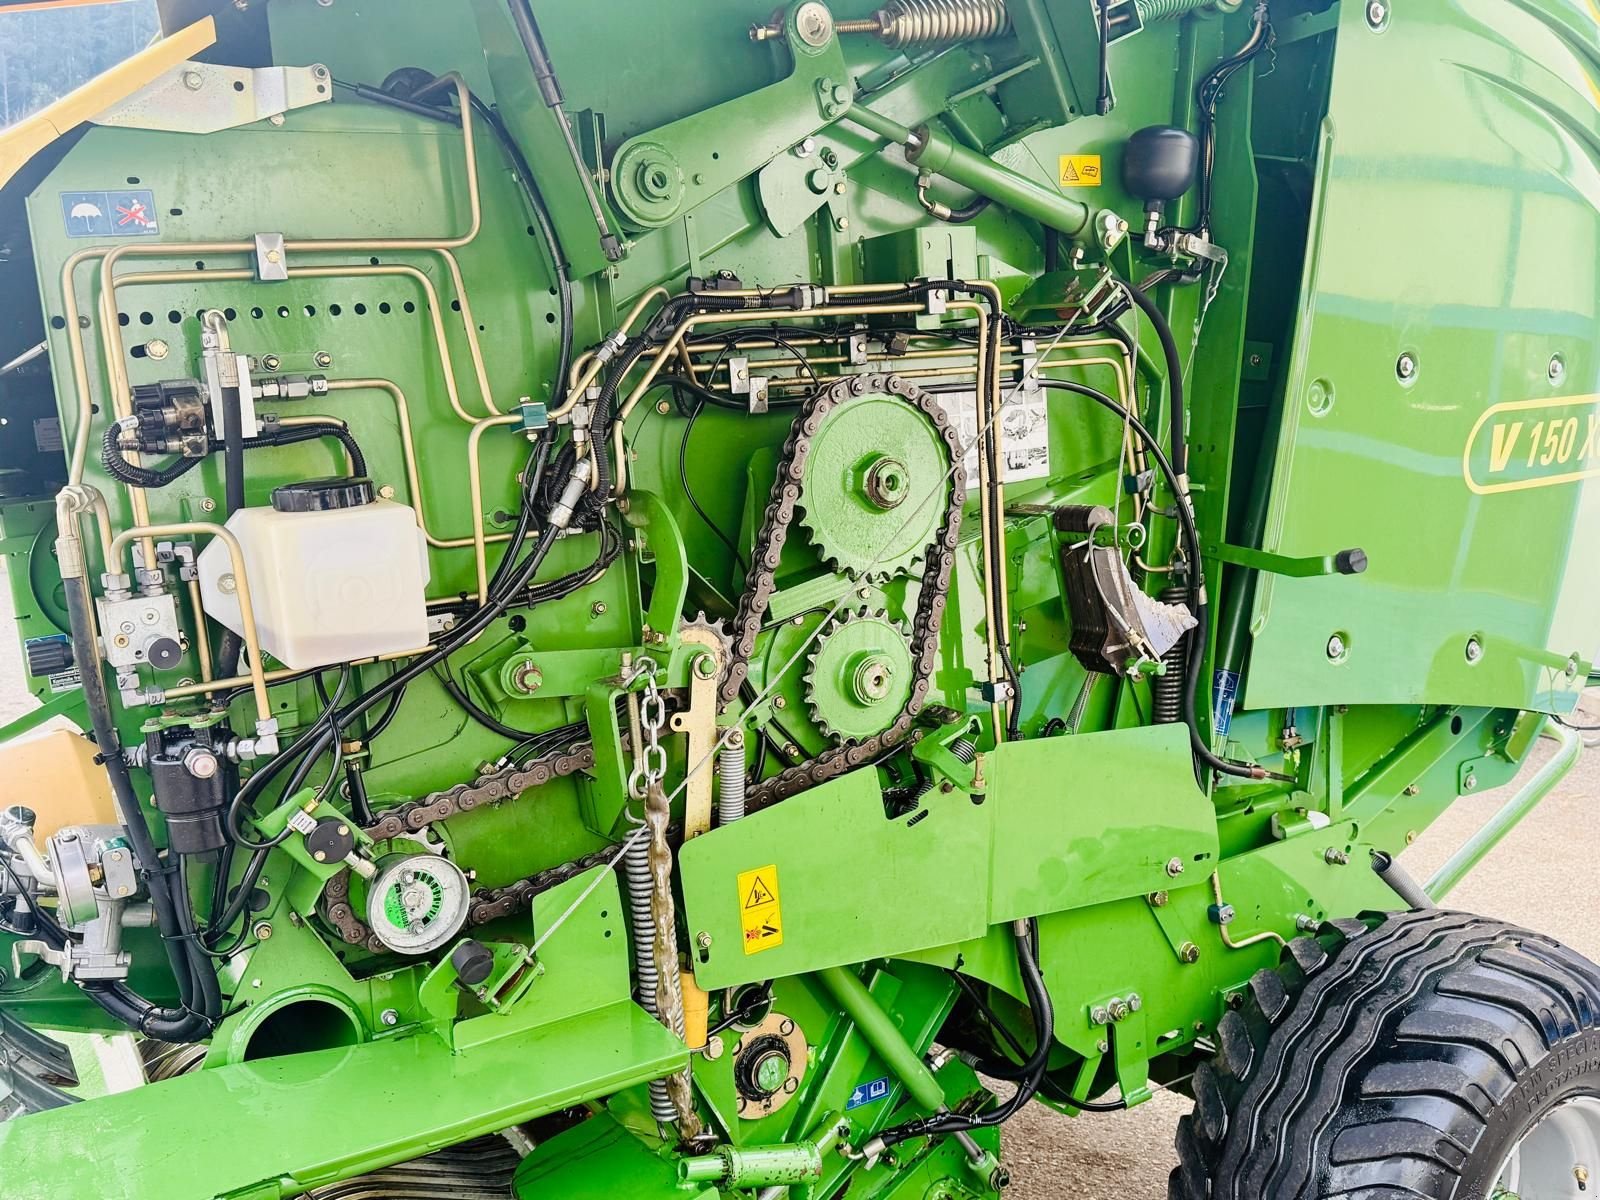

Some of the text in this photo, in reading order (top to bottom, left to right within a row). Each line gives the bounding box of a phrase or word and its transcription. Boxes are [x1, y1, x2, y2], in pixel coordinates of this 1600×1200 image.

[1488, 414, 1600, 472] V 150 X
[1502, 1035, 1600, 1120] FARM SPECIA
[1526, 1056, 1600, 1113] FLOTATIO
